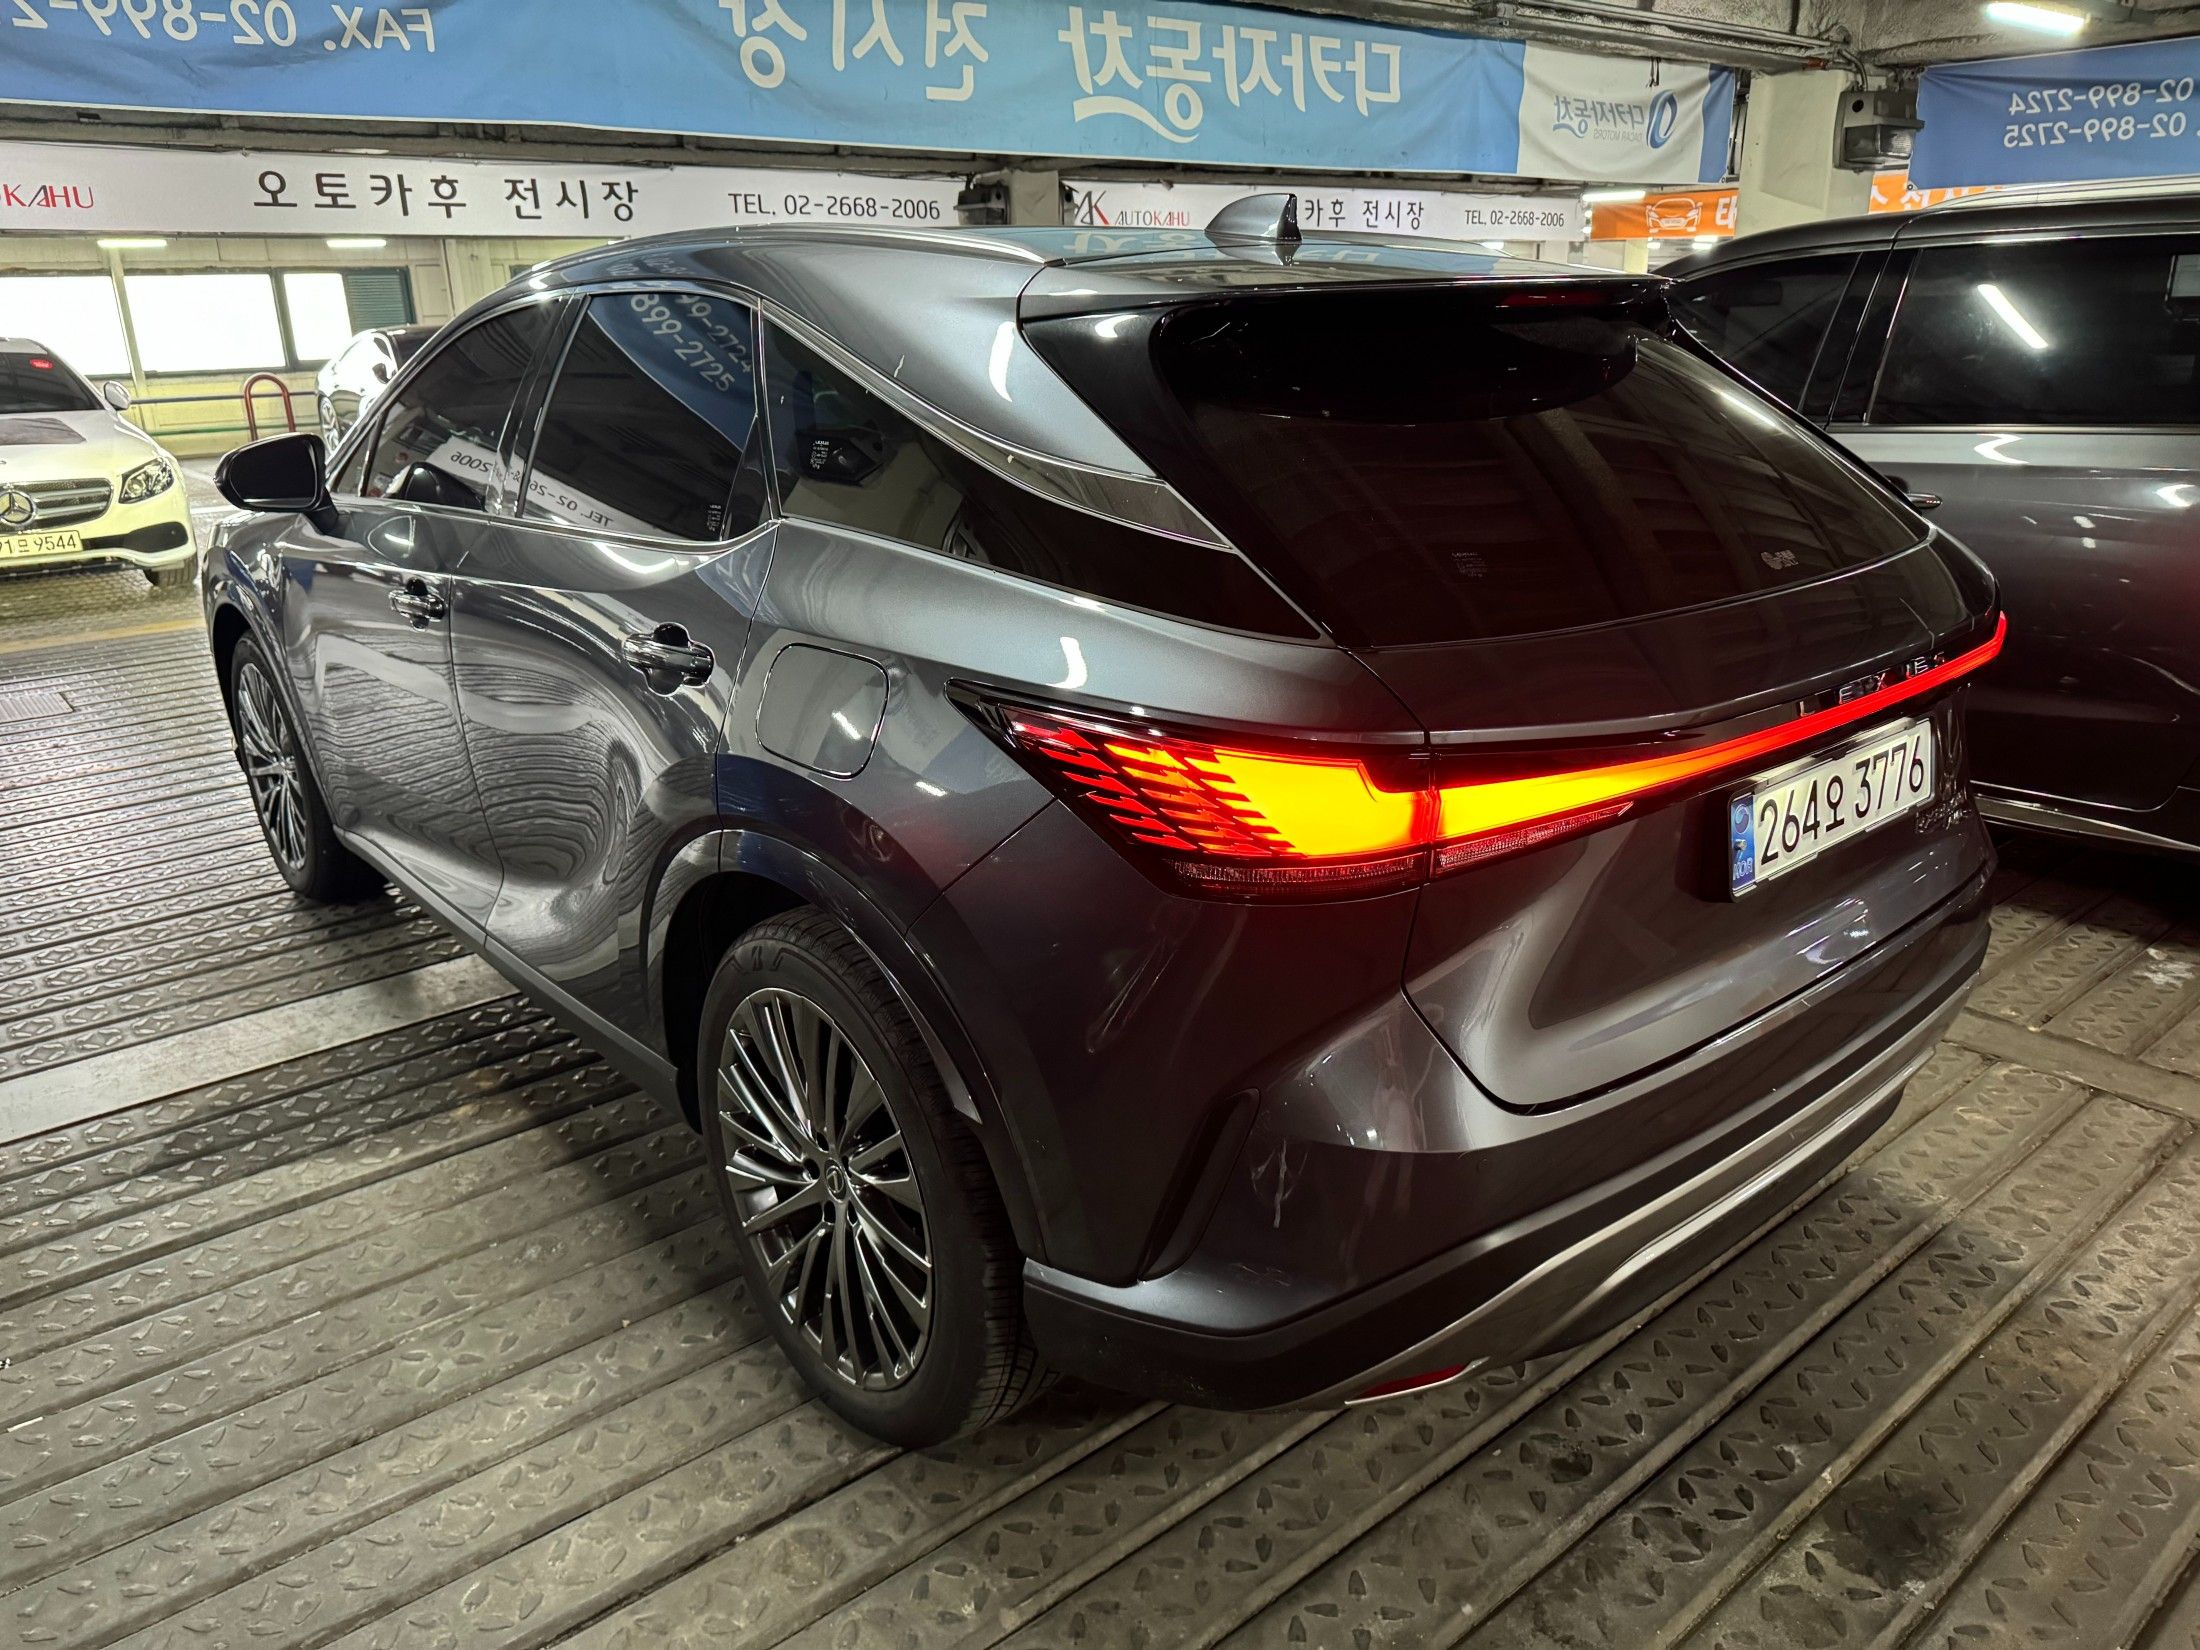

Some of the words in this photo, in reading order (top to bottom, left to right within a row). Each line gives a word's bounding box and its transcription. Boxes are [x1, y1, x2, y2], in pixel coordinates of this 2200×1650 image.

[0, 184, 94, 209] KAHU
[253, 171, 467, 219] 오토카후
[504, 178, 639, 222] 전시장
[728, 193, 776, 216] TEL.
[784, 194, 941, 220] 02-2668-2006
[1115, 210, 1190, 227] AUTOKAHU
[1304, 198, 1346, 228] 카후
[1362, 199, 1424, 230] 전시장
[1490, 211, 1565, 228] 02-2668-2006
[33, 534, 77, 552] 9544
[1760, 774, 1845, 866] 264오
[1854, 735, 1925, 818] 3776
